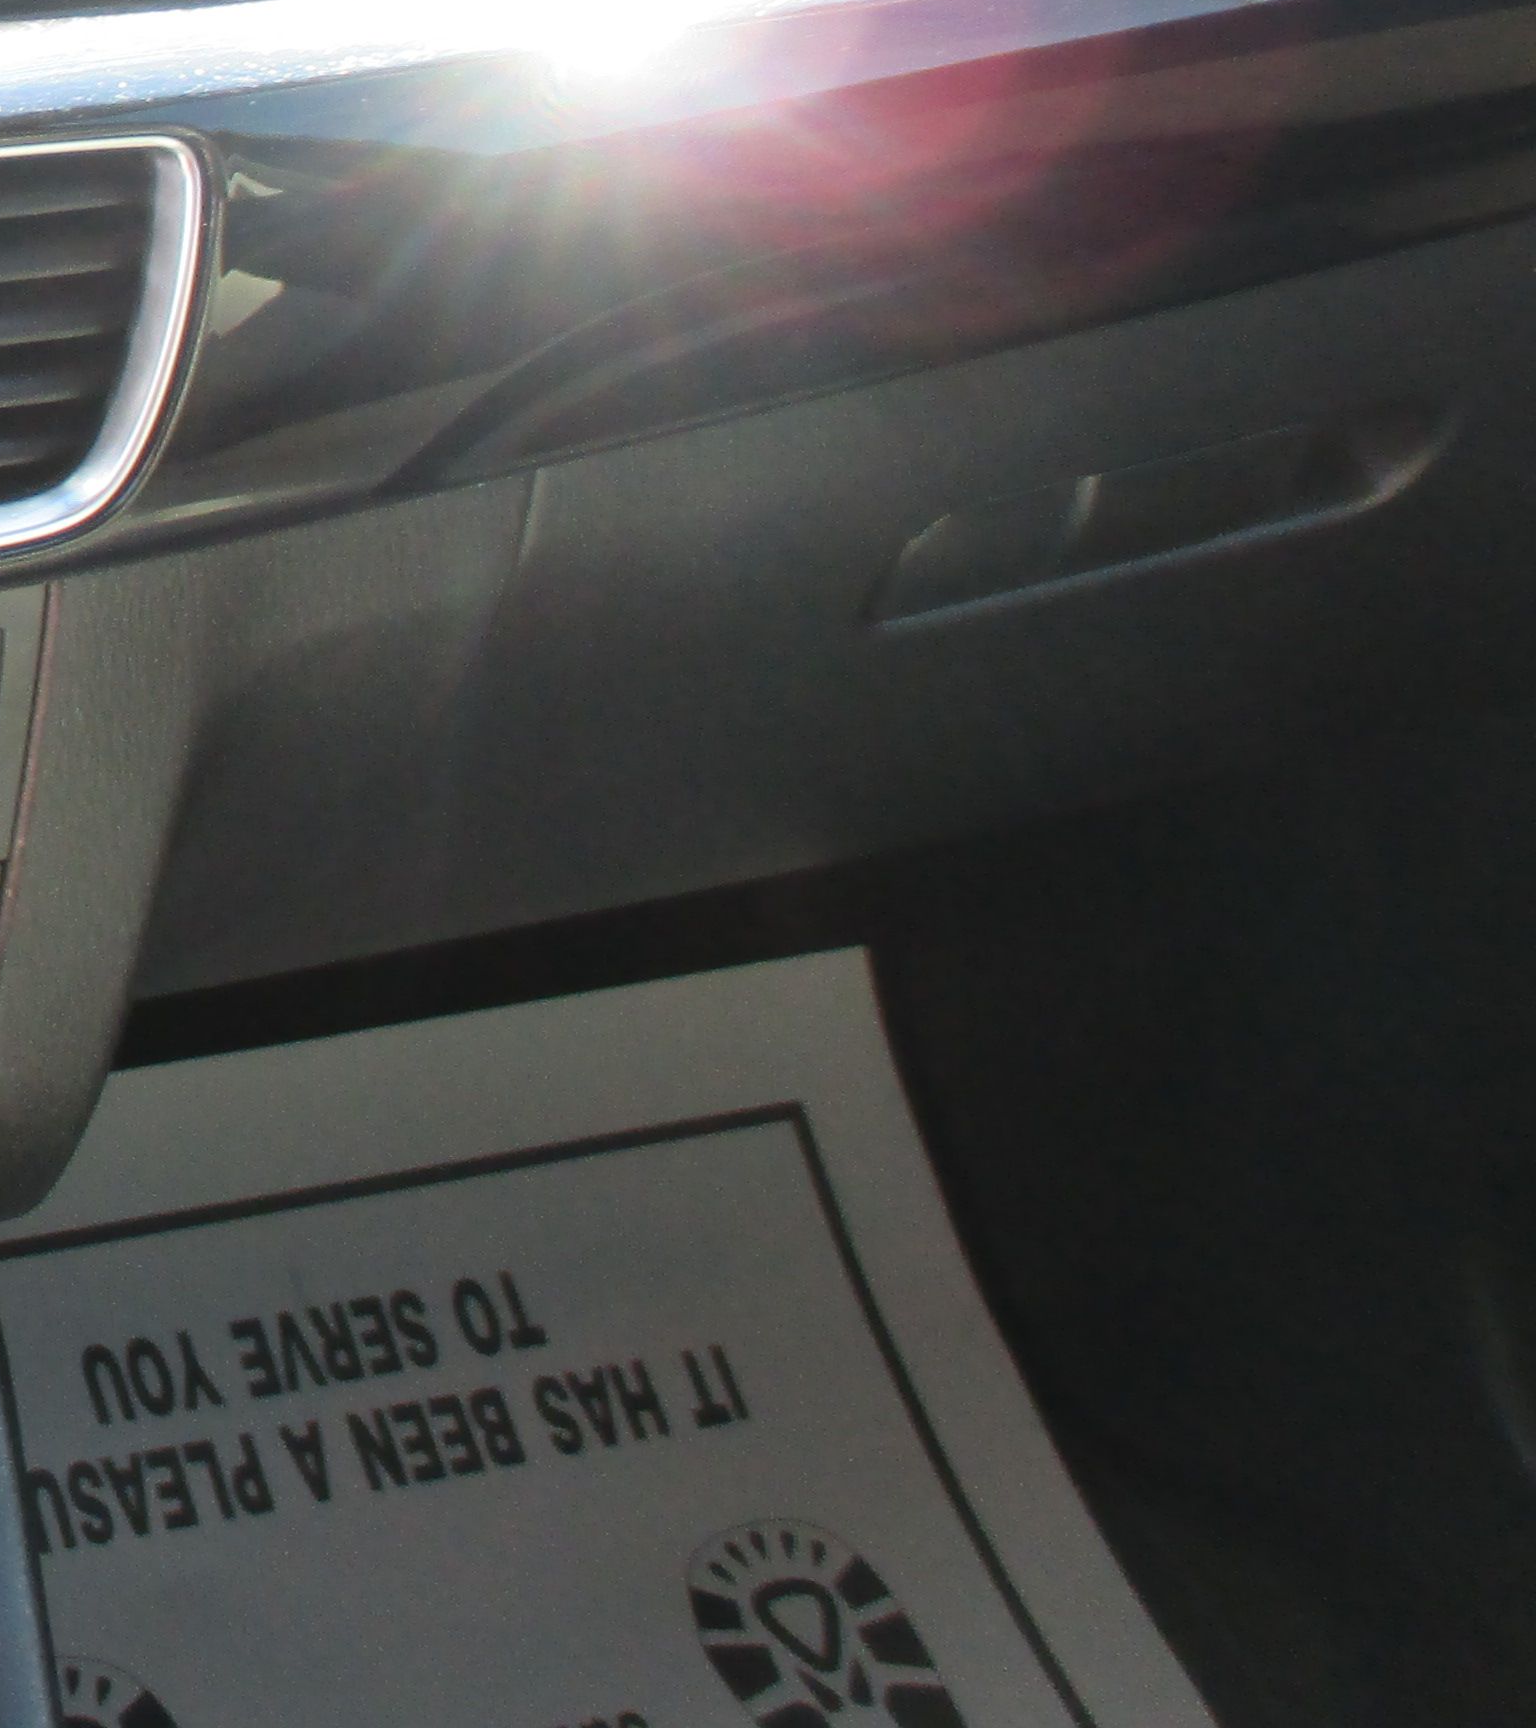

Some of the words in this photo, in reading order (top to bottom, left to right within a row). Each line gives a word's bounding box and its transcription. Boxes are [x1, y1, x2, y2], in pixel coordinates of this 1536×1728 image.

[231, 1288, 439, 1398] SERVE
[452, 1268, 548, 1357] TO
[81, 1328, 226, 1426] YOU
[532, 1357, 671, 1455] HAS
[680, 1344, 750, 1430] IT
[279, 1419, 332, 1503] A
[345, 1384, 527, 1492] BEEN
